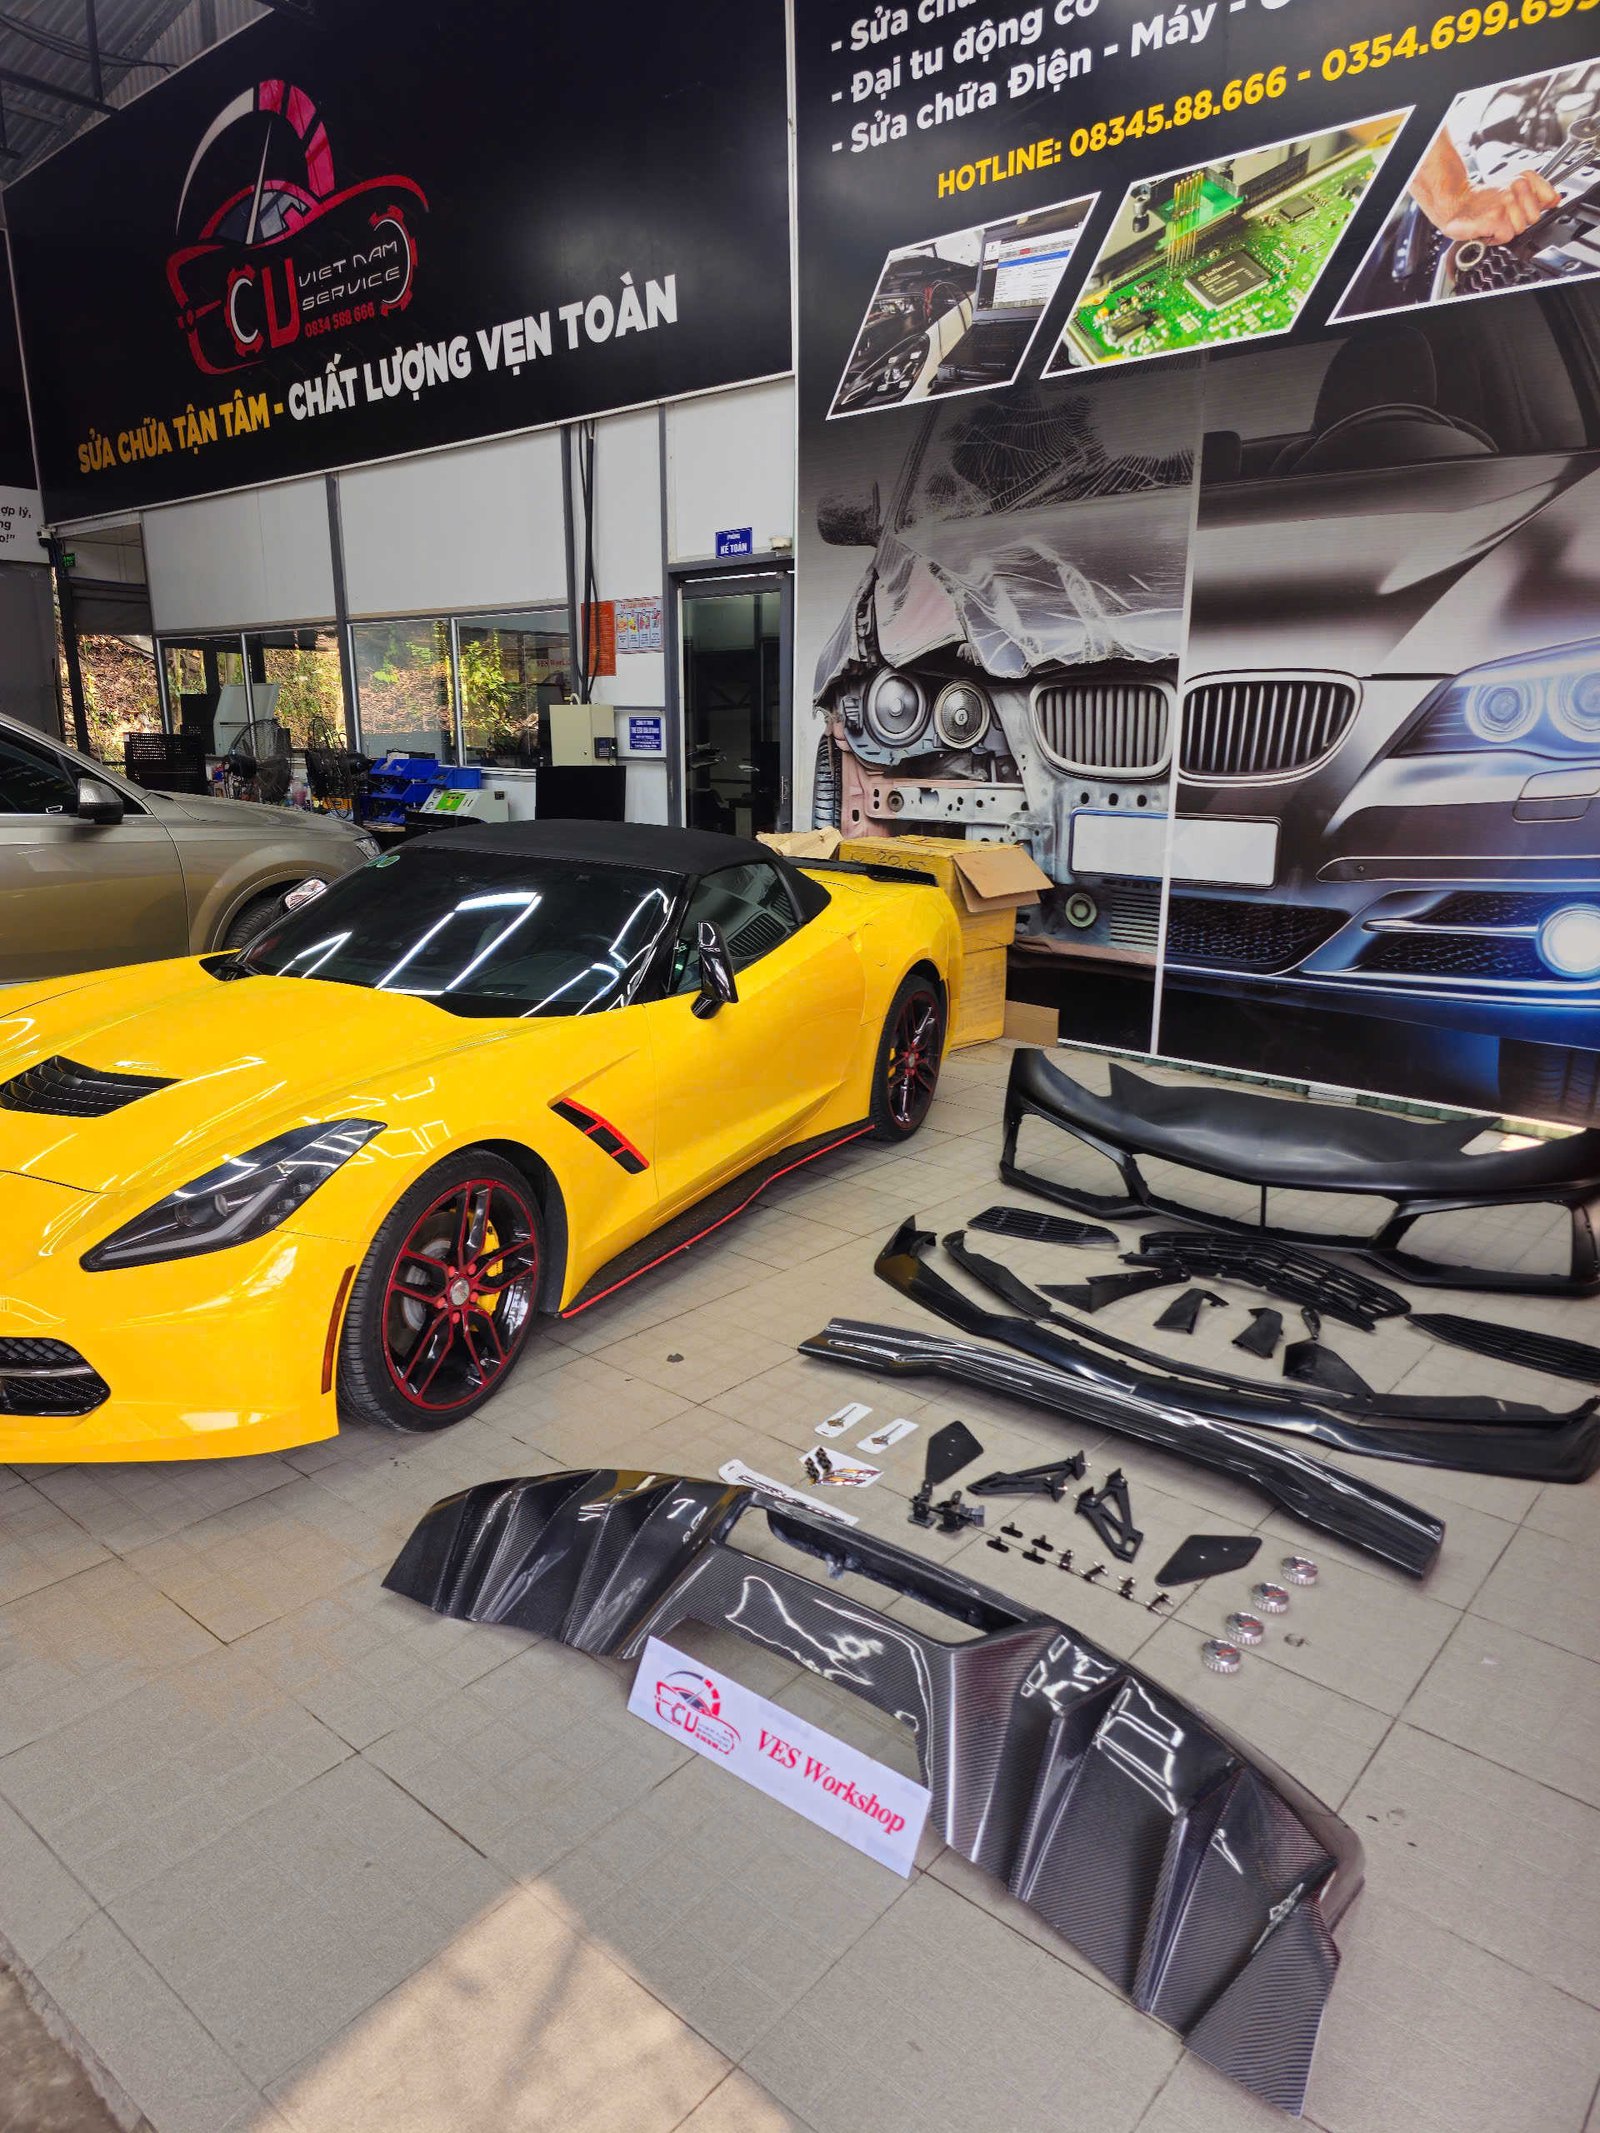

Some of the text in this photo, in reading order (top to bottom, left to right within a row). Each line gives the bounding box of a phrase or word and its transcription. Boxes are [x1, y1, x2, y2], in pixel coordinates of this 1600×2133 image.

[850, 6, 909, 51] Sửa
[850, 56, 901, 103] Đại
[909, 46, 943, 80] tu
[952, 8, 1043, 63] động
[850, 110, 908, 153] Sửa
[916, 81, 997, 130] chữa
[1007, 47, 1092, 99] Điện
[1131, 2, 1218, 58] Máy
[937, 137, 1063, 199] HOTLINE:
[1069, 65, 1287, 158] 08345.88.666
[298, 241, 398, 288] VIET NAM
[302, 266, 401, 311] SERVICE
[78, 428, 117, 474] SỬA
[117, 417, 173, 464] CHỮA
[173, 403, 218, 455] TẬN
[218, 389, 271, 437] TÂM
[288, 353, 358, 421] CHẤT
[364, 336, 472, 401] LƯỢNG
[476, 311, 553, 376] VẸN
[559, 271, 678, 349] TOÀN
[305, 315, 331, 338] 0834
[757, 1728, 802, 1769] VES
[803, 1755, 906, 1835] Workshop
